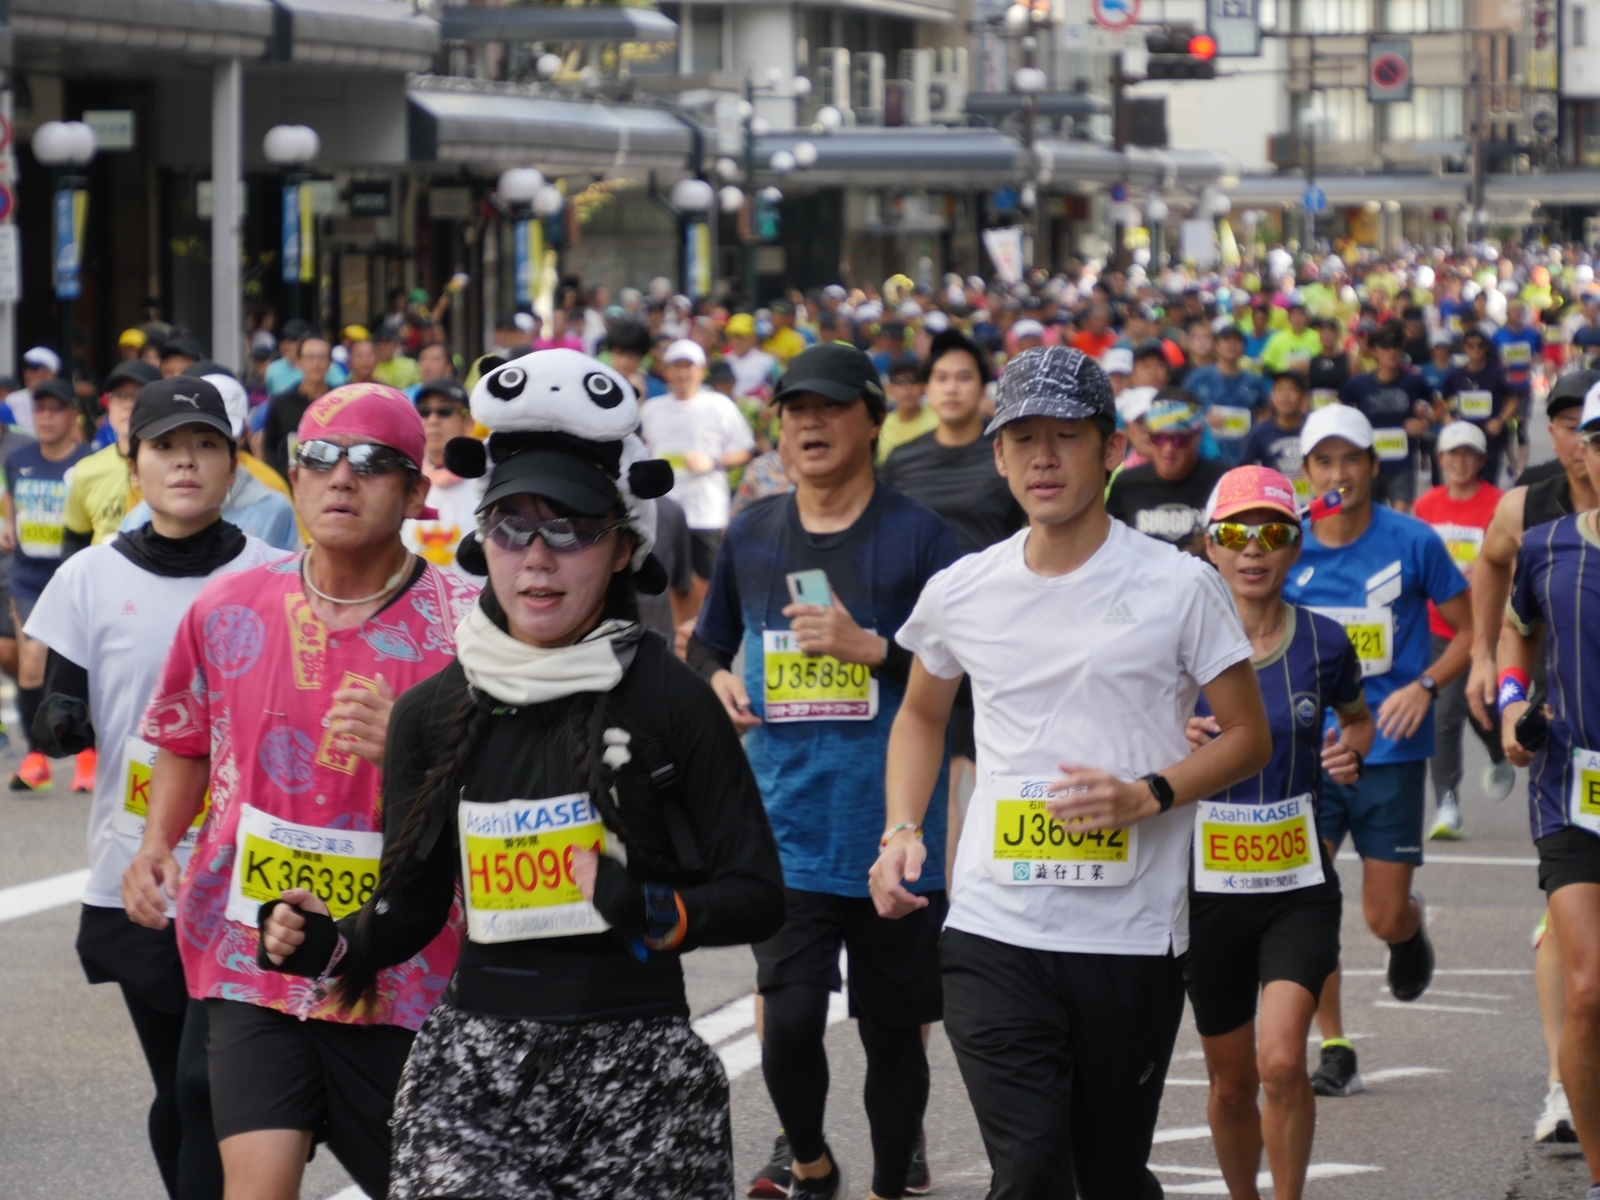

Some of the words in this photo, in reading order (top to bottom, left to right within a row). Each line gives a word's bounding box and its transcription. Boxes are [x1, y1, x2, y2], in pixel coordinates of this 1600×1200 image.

[766, 662, 866, 690] J35850
[1028, 801, 1047, 811] 石川
[1209, 806, 1251, 823] Asahi
[1252, 801, 1300, 823] KASEI
[466, 809, 512, 834] Asahi
[1210, 827, 1306, 862] E65205
[245, 850, 377, 907] K36338
